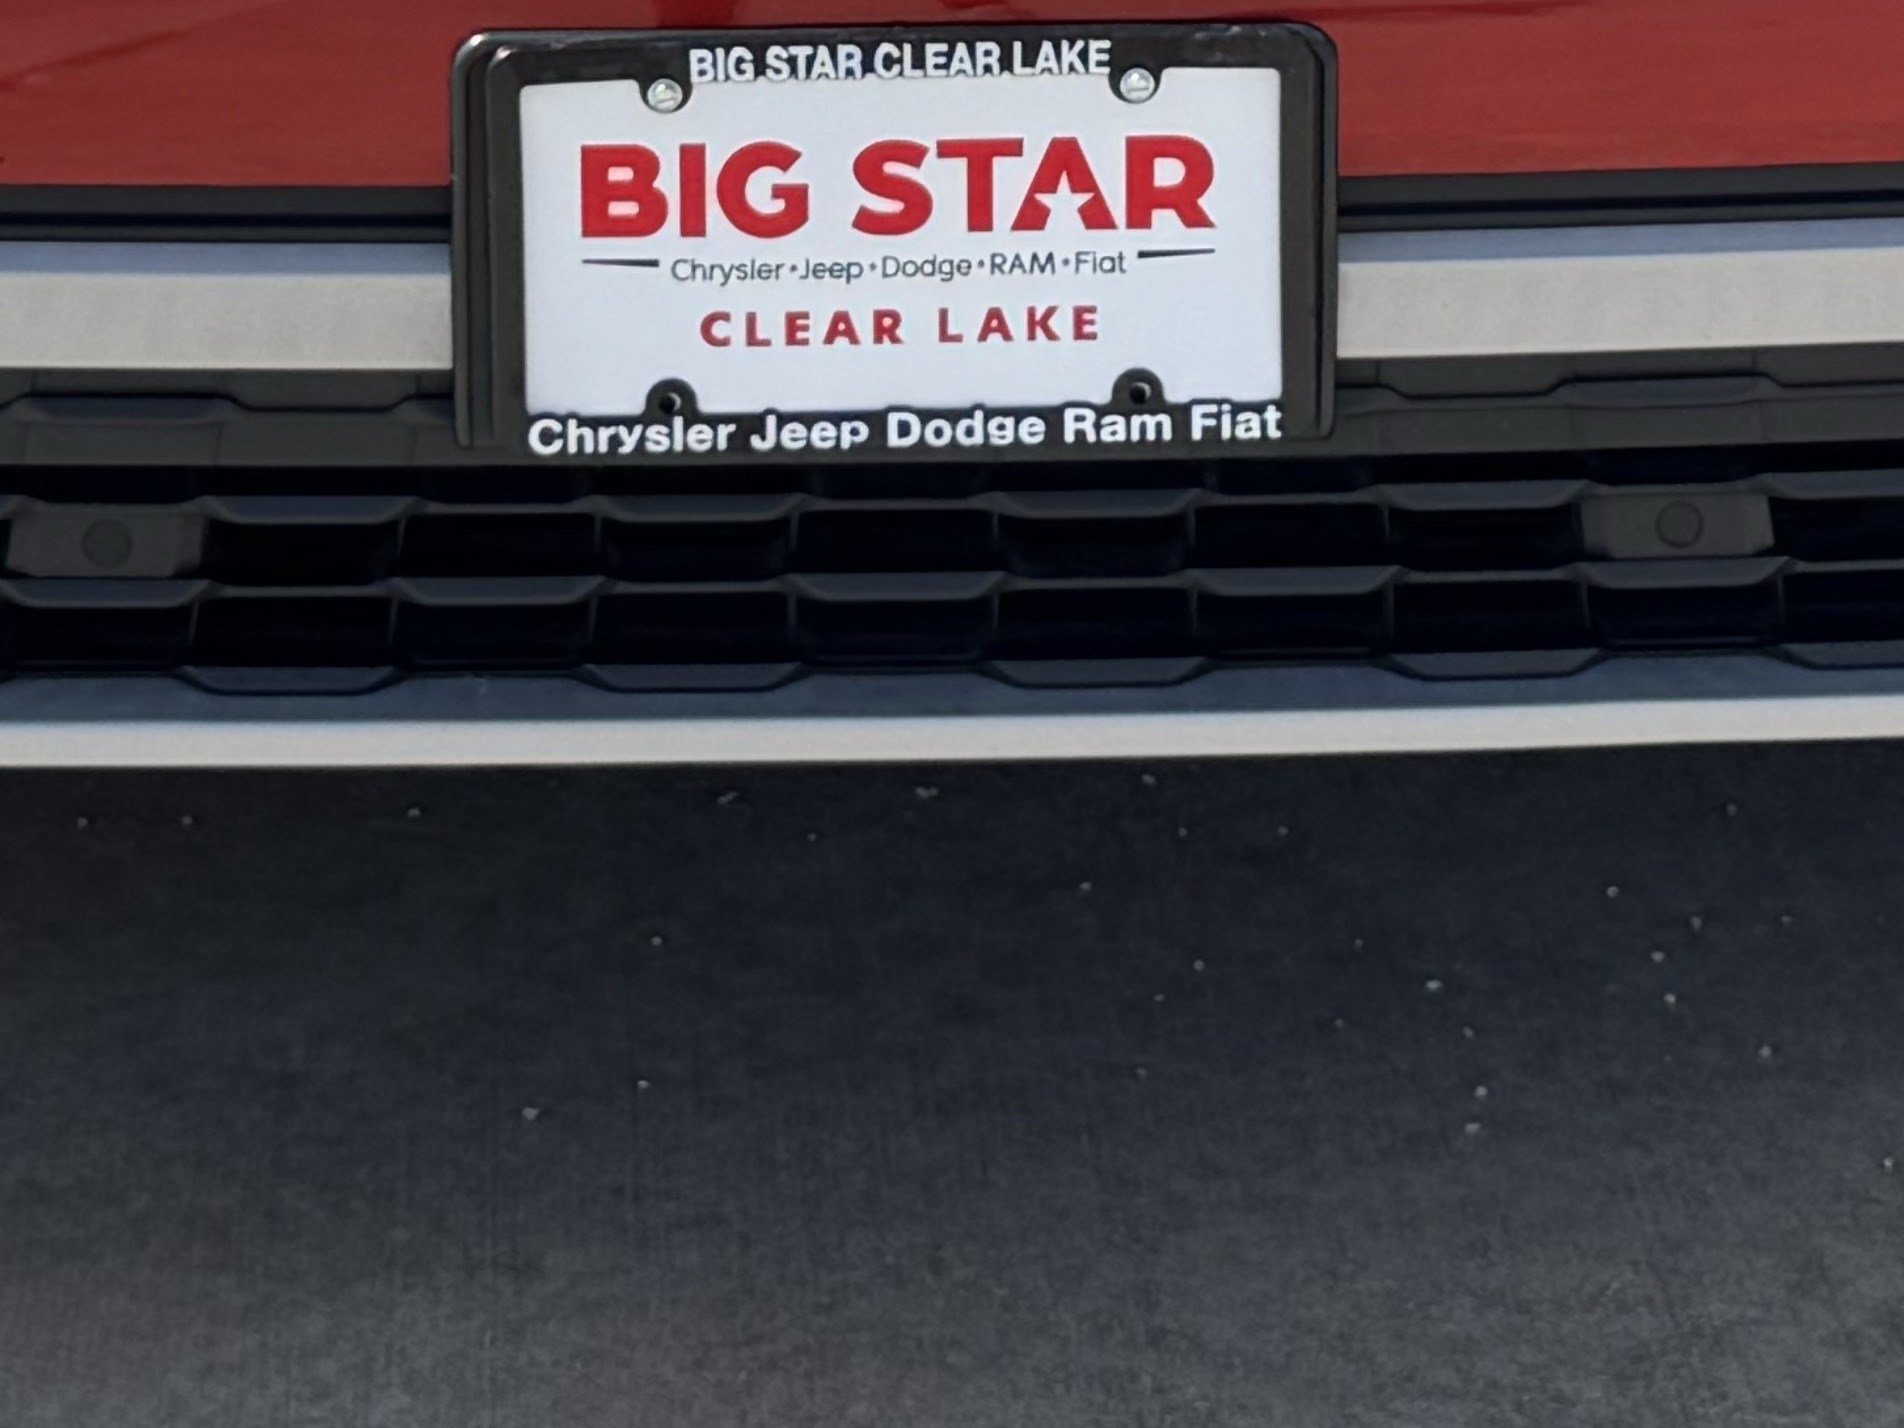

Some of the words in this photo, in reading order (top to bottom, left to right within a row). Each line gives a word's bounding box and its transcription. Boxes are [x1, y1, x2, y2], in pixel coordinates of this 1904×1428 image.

[688, 46, 755, 83] BIG
[763, 43, 863, 81] STAR
[873, 41, 1001, 79] CLEAR
[1012, 39, 1112, 76] LAKE
[580, 140, 810, 239] BIG
[851, 135, 1217, 236] STAR
[670, 257, 785, 287] Chrysler
[798, 256, 864, 284] Jeep
[880, 253, 972, 282] Dodge
[989, 251, 1056, 276] RAM
[1073, 250, 1128, 275] Fiat
[699, 309, 904, 348] CLEAR
[937, 304, 1098, 344] LAKE
[527, 414, 737, 456] Chrysler
[749, 413, 870, 451] Jeep
[886, 408, 1047, 448] Dodge
[1062, 406, 1173, 444] Ram
[1190, 402, 1283, 442] Fiat
